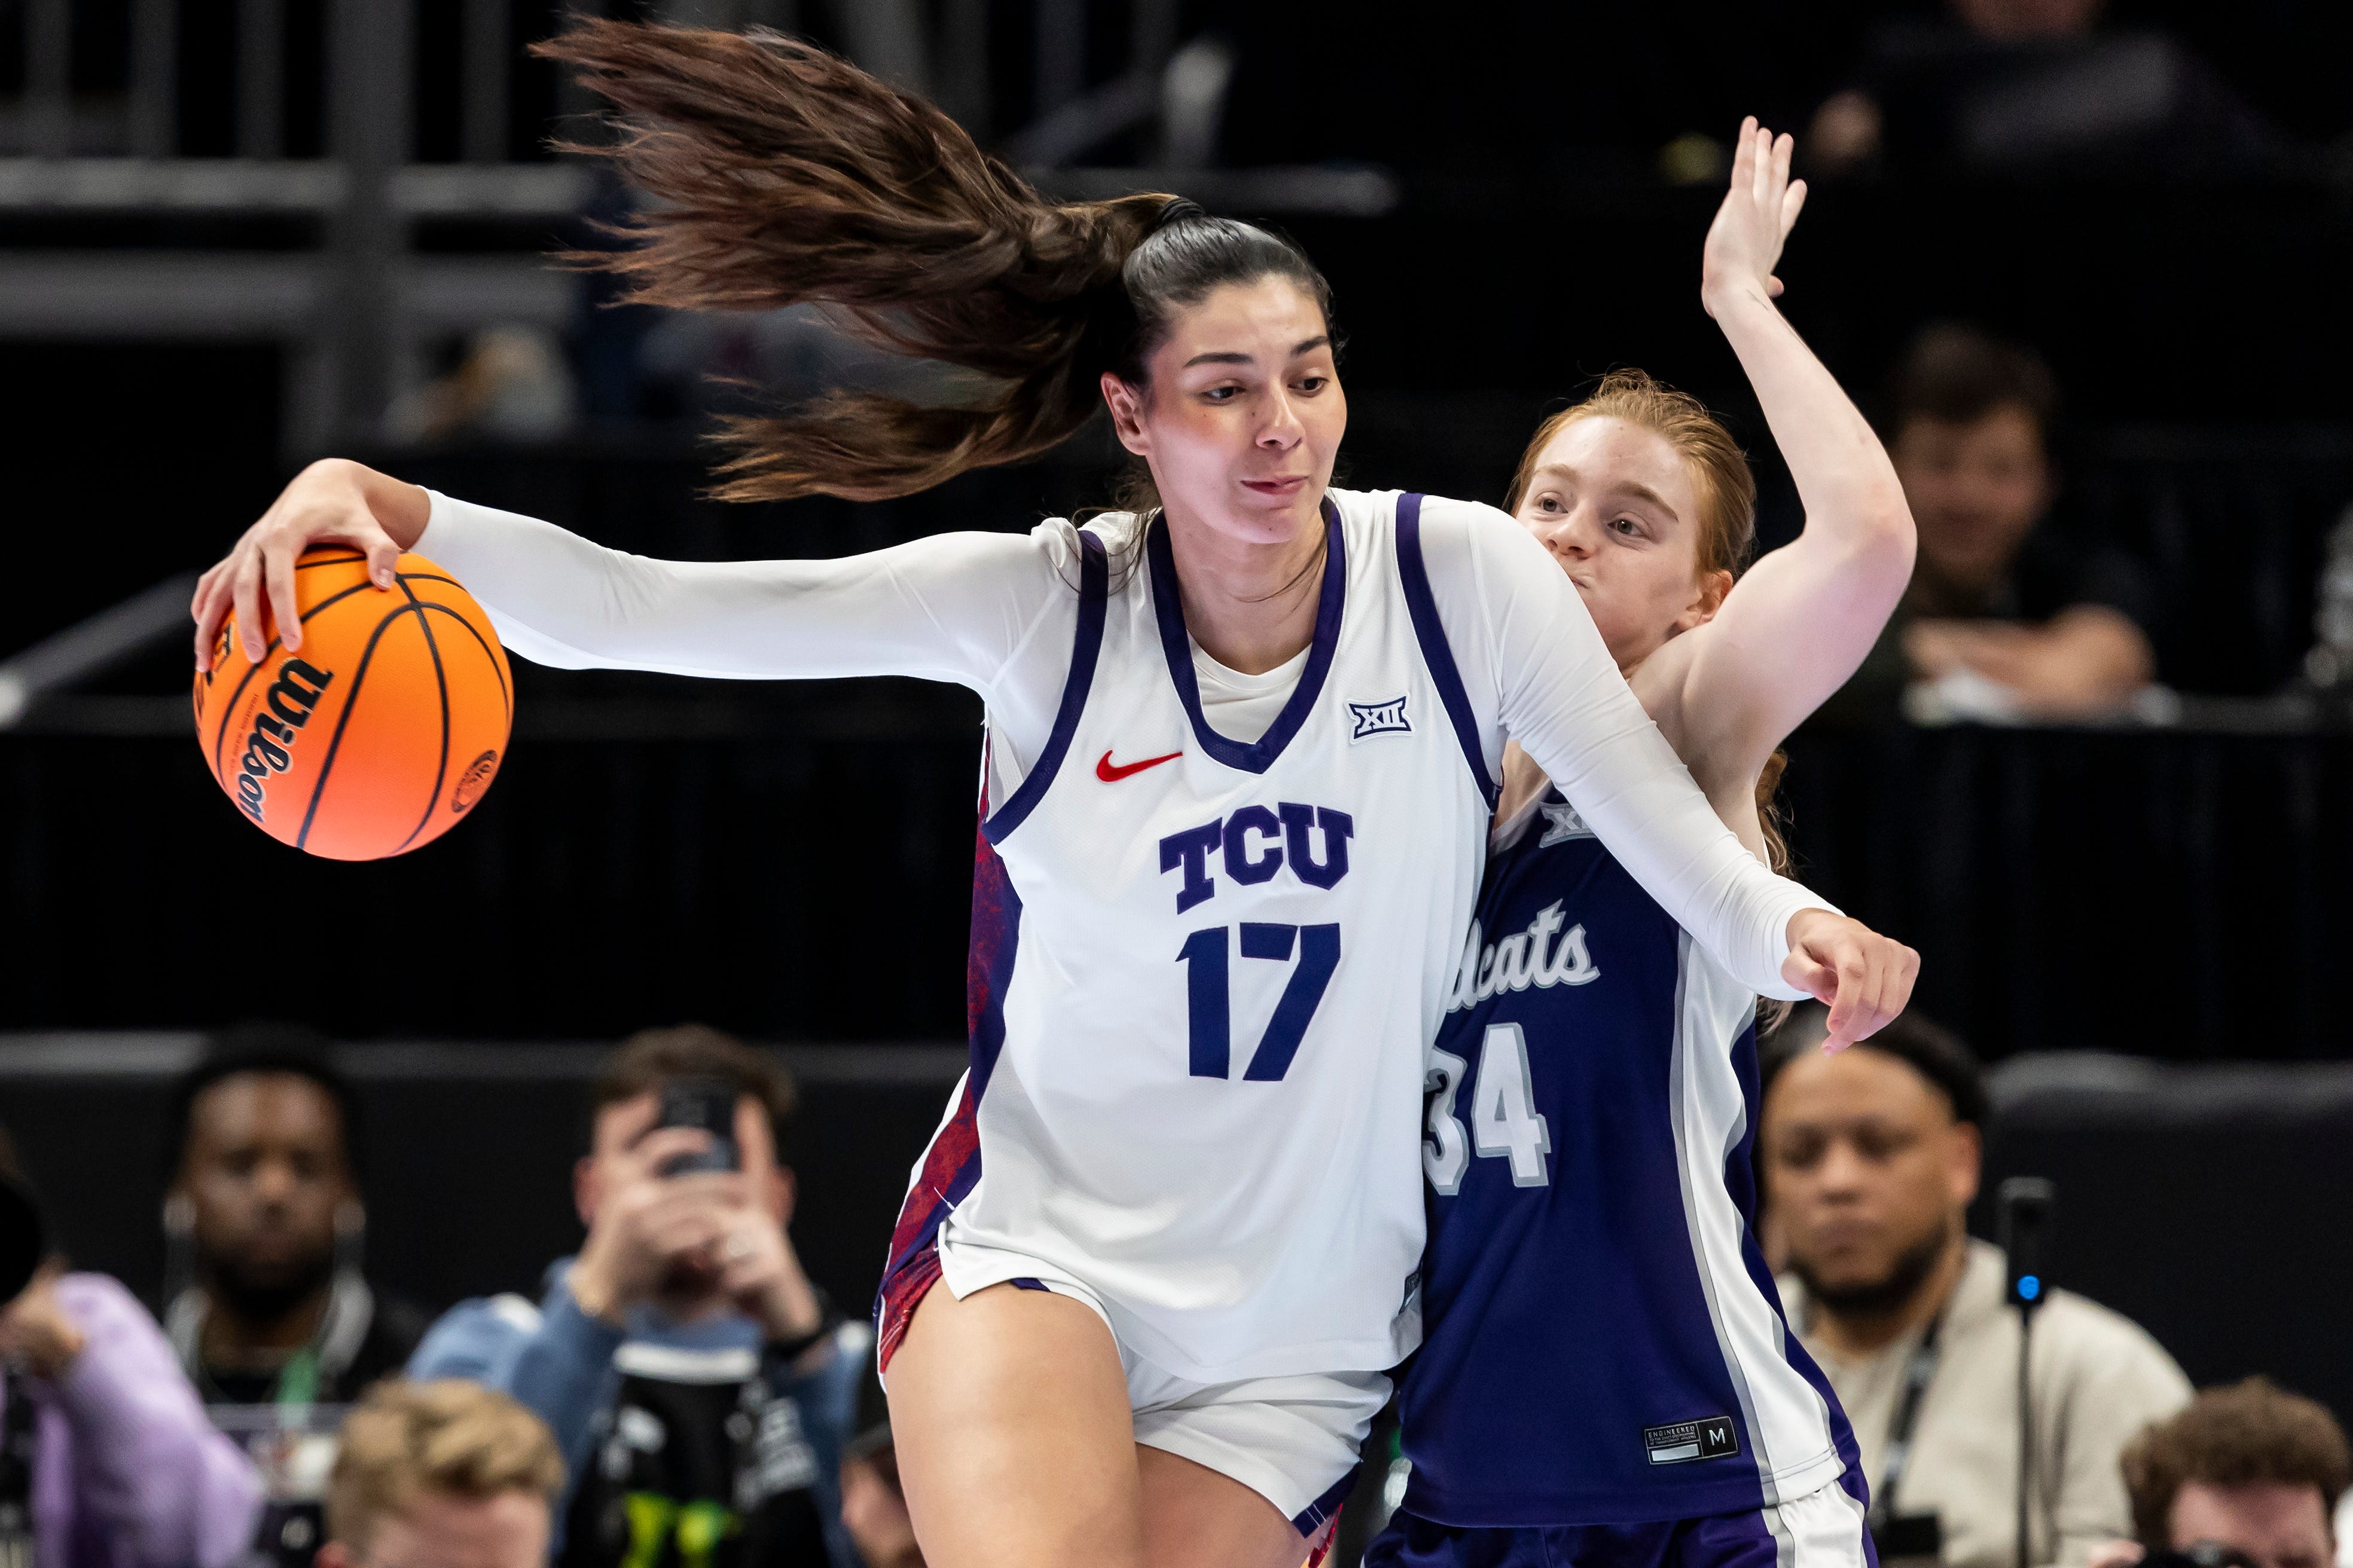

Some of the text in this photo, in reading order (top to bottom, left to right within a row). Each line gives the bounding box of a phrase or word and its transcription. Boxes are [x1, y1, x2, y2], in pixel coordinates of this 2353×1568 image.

[237, 656, 335, 823] Wilson
[1350, 696, 1410, 738] XII
[1159, 802, 1354, 915] TCU
[1175, 922, 1341, 1082] 17
[1446, 898, 1601, 1013] dcats
[1422, 1022, 1551, 1196] 34
[1648, 1426, 1695, 1437] ENGINEERED
[1708, 1428, 1726, 1446] M
